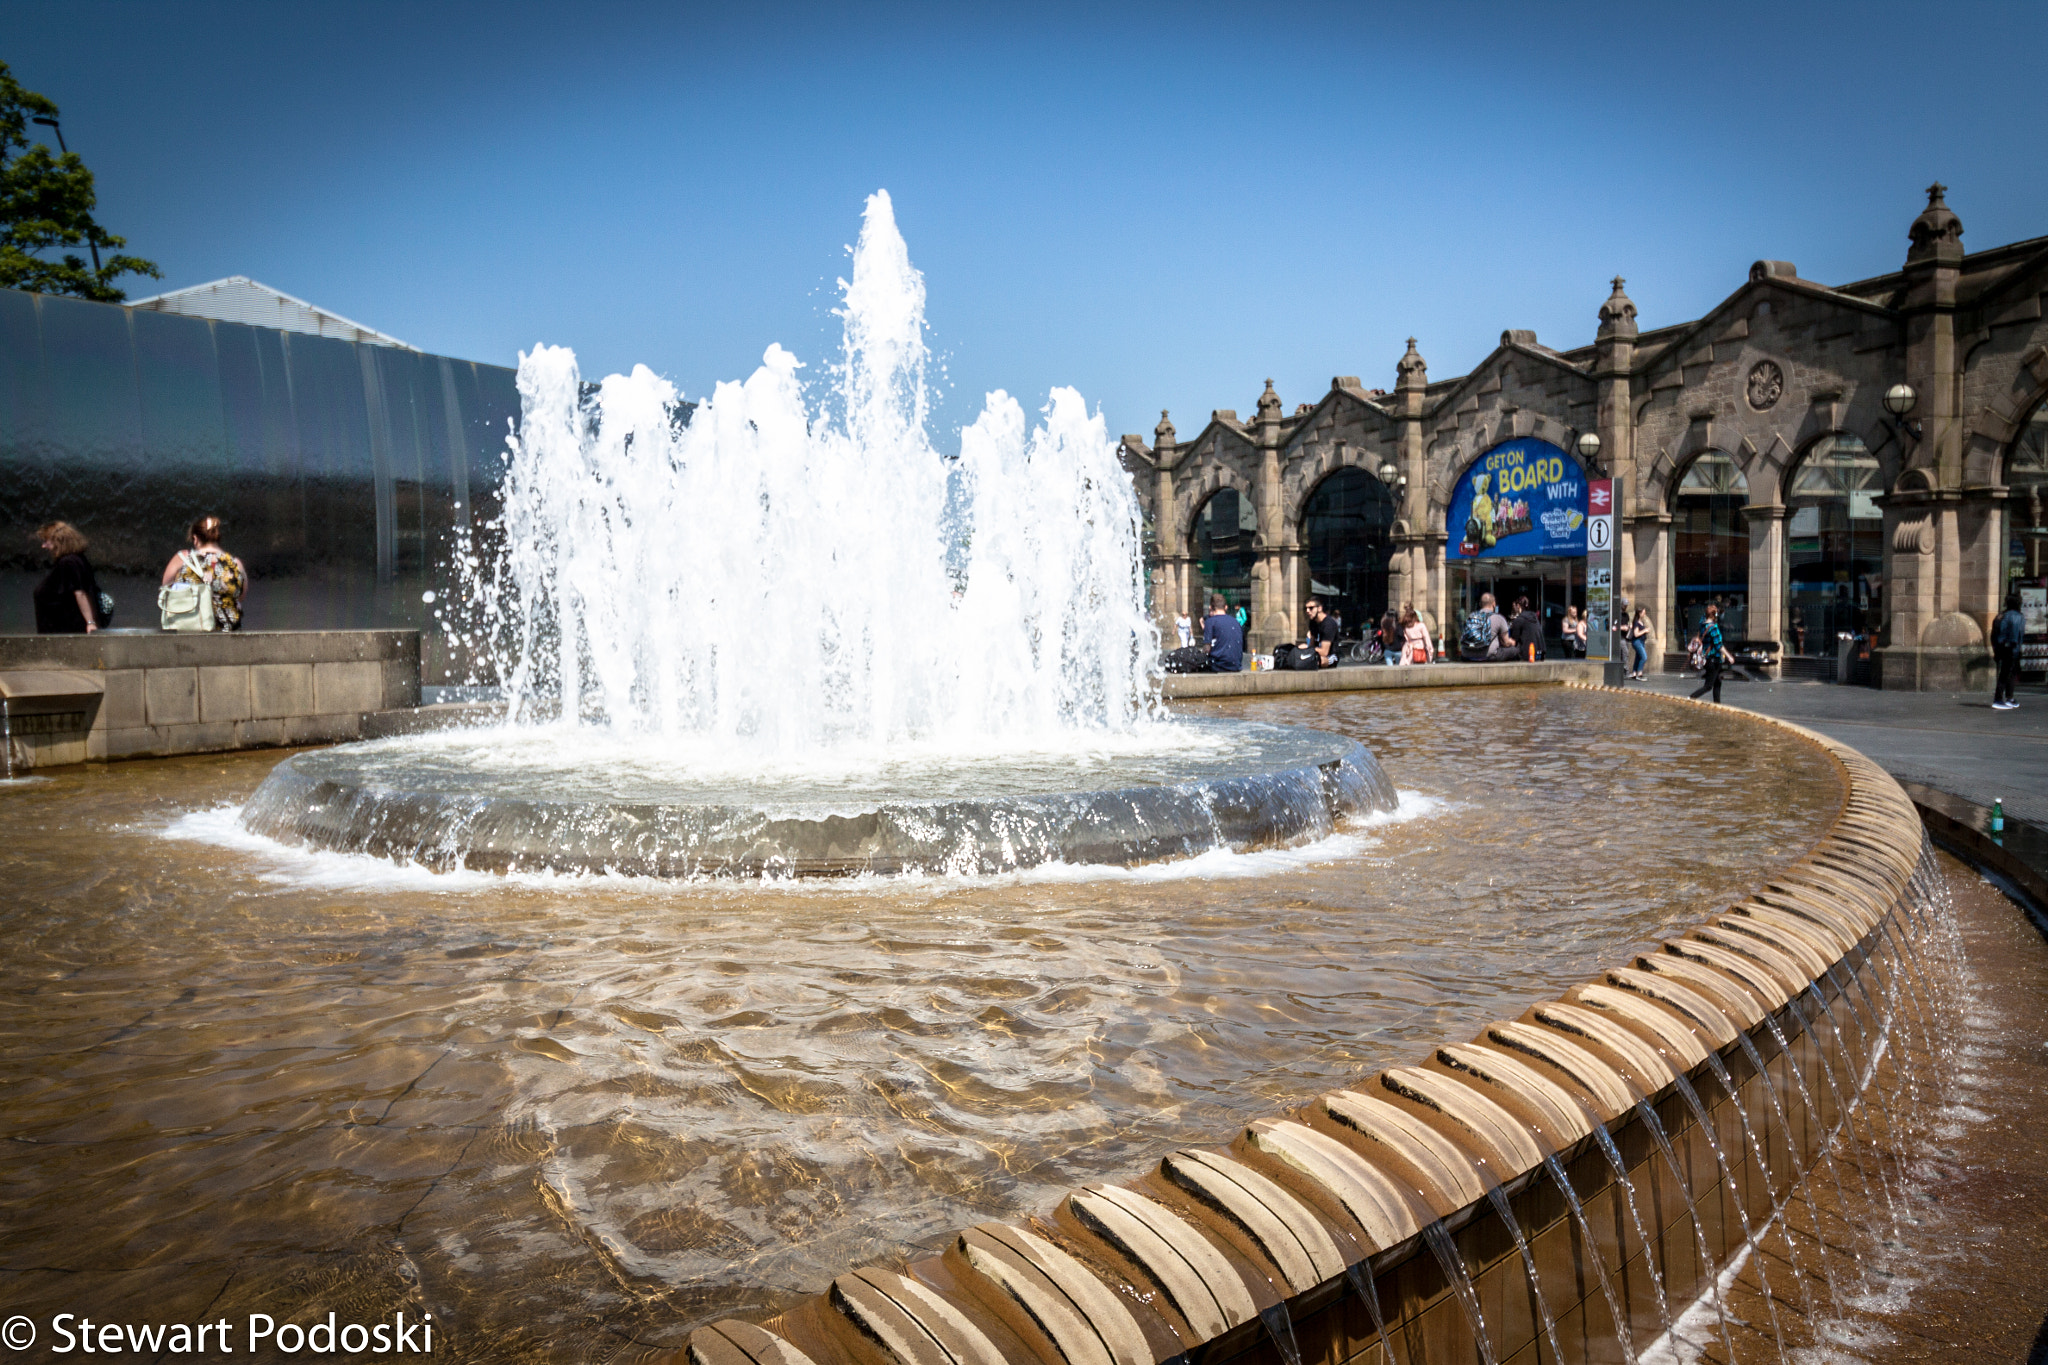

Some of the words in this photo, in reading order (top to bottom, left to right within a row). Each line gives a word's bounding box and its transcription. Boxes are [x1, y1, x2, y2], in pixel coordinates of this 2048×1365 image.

[1486, 454, 1506, 471] GET
[1507, 451, 1524, 466] ON
[1499, 458, 1563, 493] BOARD
[1547, 483, 1578, 500] WITH
